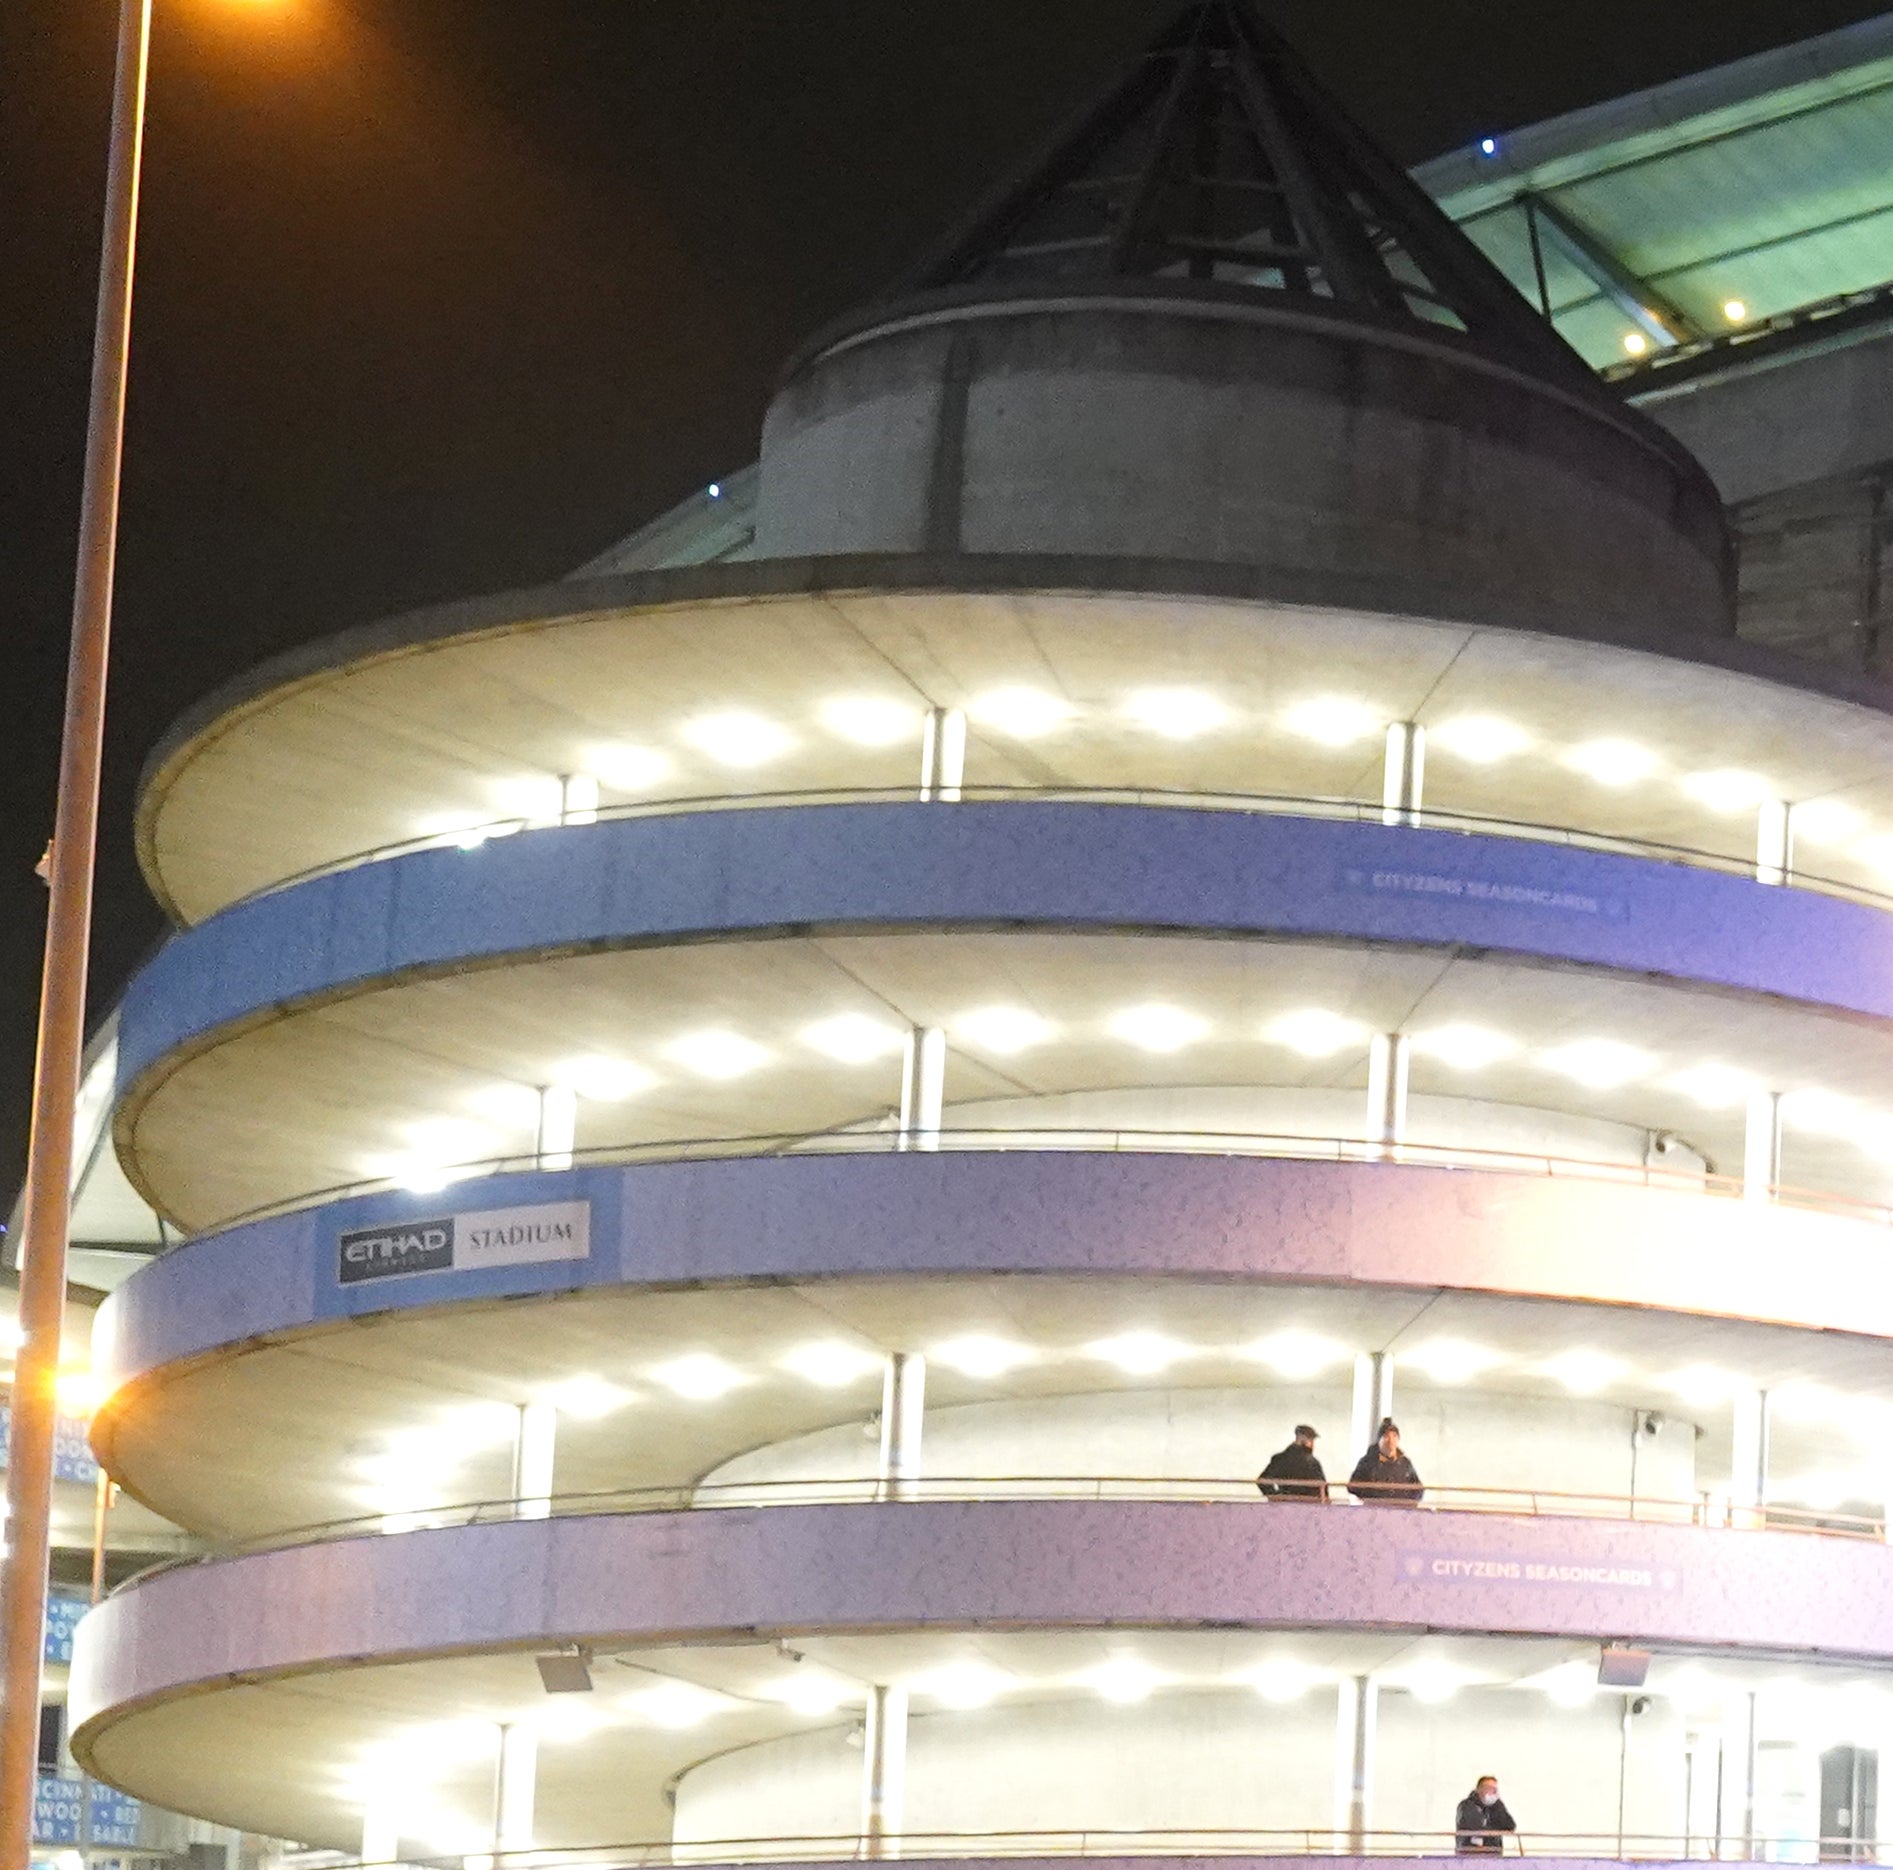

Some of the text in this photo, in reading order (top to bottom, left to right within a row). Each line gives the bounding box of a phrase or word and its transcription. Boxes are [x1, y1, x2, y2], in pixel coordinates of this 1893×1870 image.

[346, 1222, 573, 1262] ETIHAD STADIUM
[1431, 1560, 1652, 1586] CITYZENS SEASONCARDS
